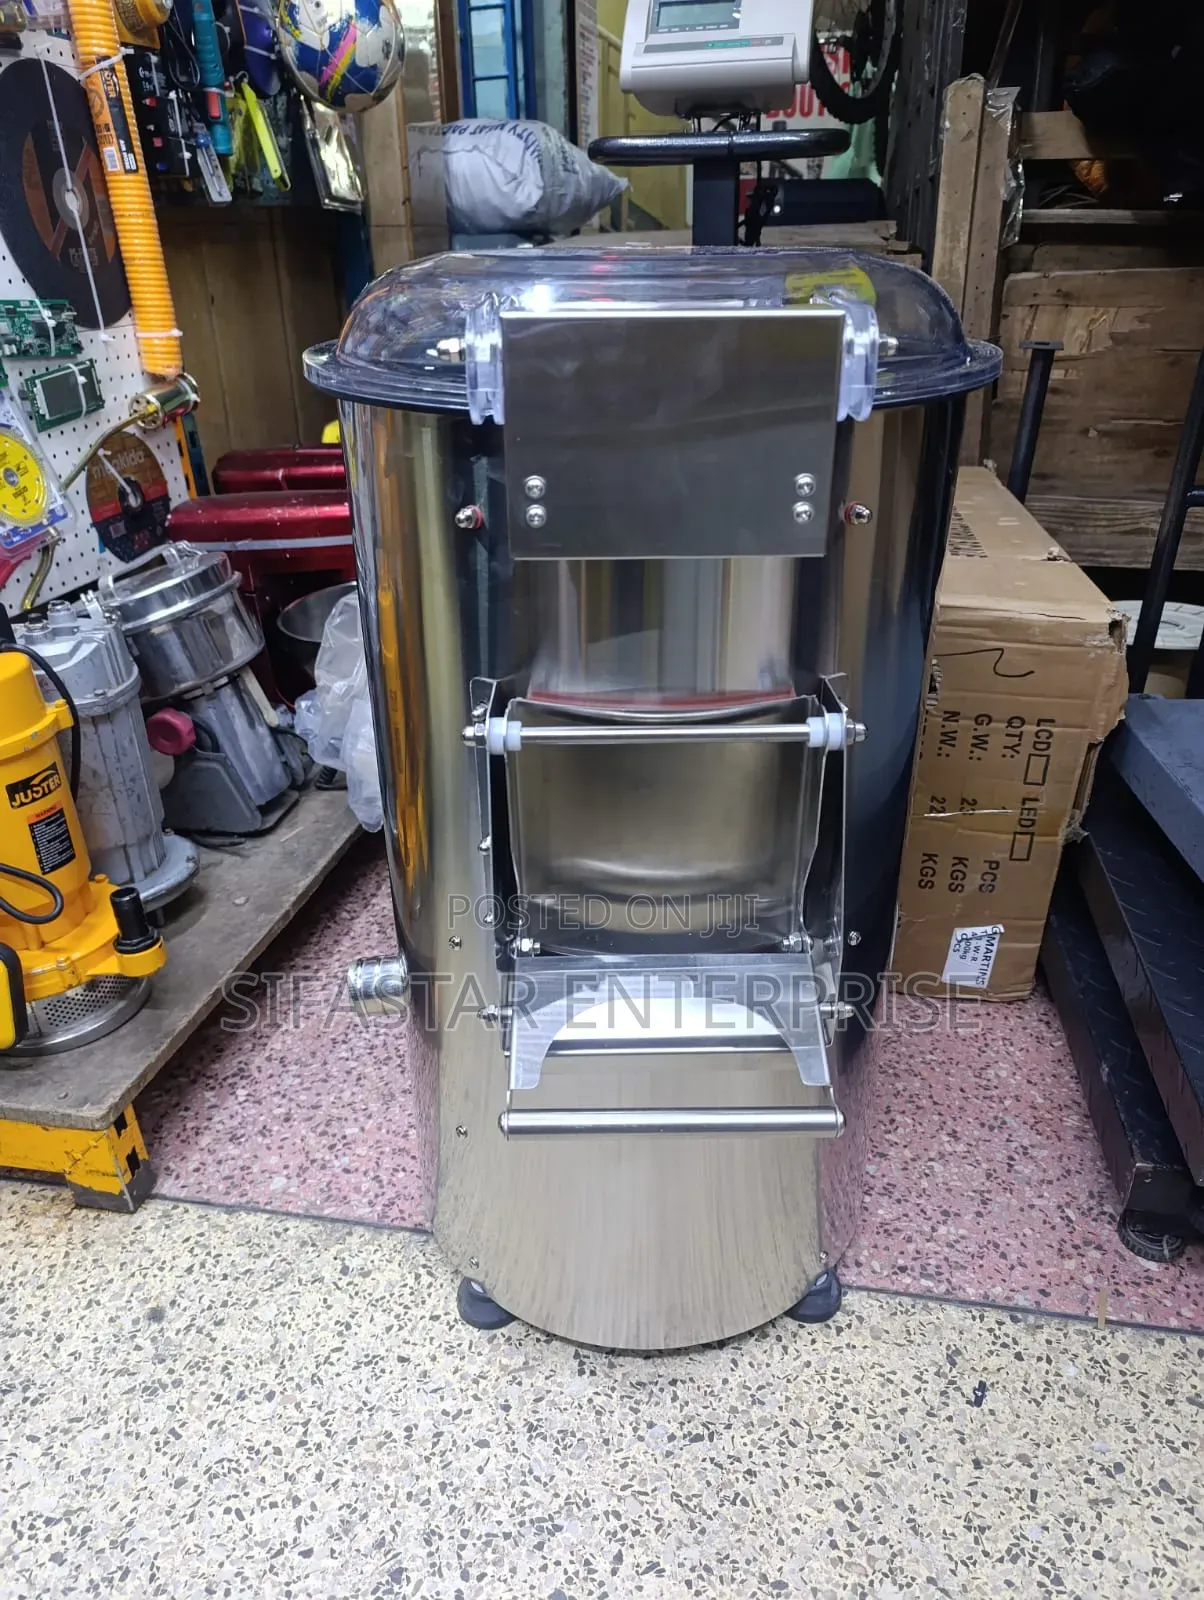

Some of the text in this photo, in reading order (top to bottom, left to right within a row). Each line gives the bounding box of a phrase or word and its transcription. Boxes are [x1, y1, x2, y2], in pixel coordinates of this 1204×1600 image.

[937, 710, 961, 758] N.W.:
[968, 713, 993, 761] G.W.:
[1001, 715, 1026, 759] QTY:
[11, 773, 61, 807] JUSTER
[1018, 718, 1056, 829] LCD LED
[918, 852, 939, 890] KGS
[948, 856, 969, 894] KGS
[978, 859, 1000, 894] PCS
